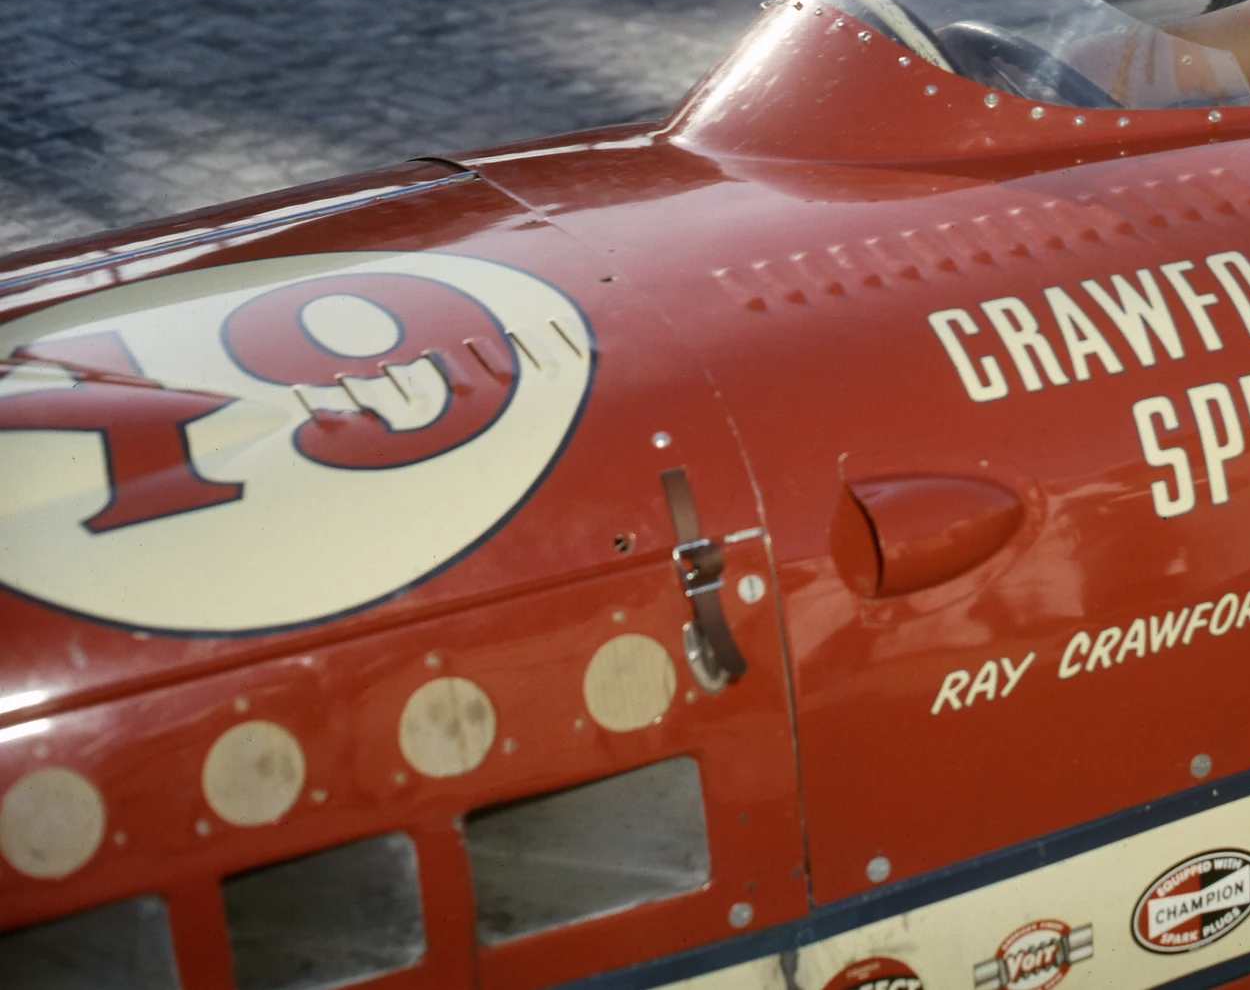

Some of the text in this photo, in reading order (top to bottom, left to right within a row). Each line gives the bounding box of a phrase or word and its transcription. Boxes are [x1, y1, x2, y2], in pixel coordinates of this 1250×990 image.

[931, 652, 1035, 715] RAY
[1156, 857, 1243, 898] EQUIPPED WITH
[1155, 880, 1244, 924] CHAMPION
[1160, 906, 1242, 945] SPARK PLUGS
